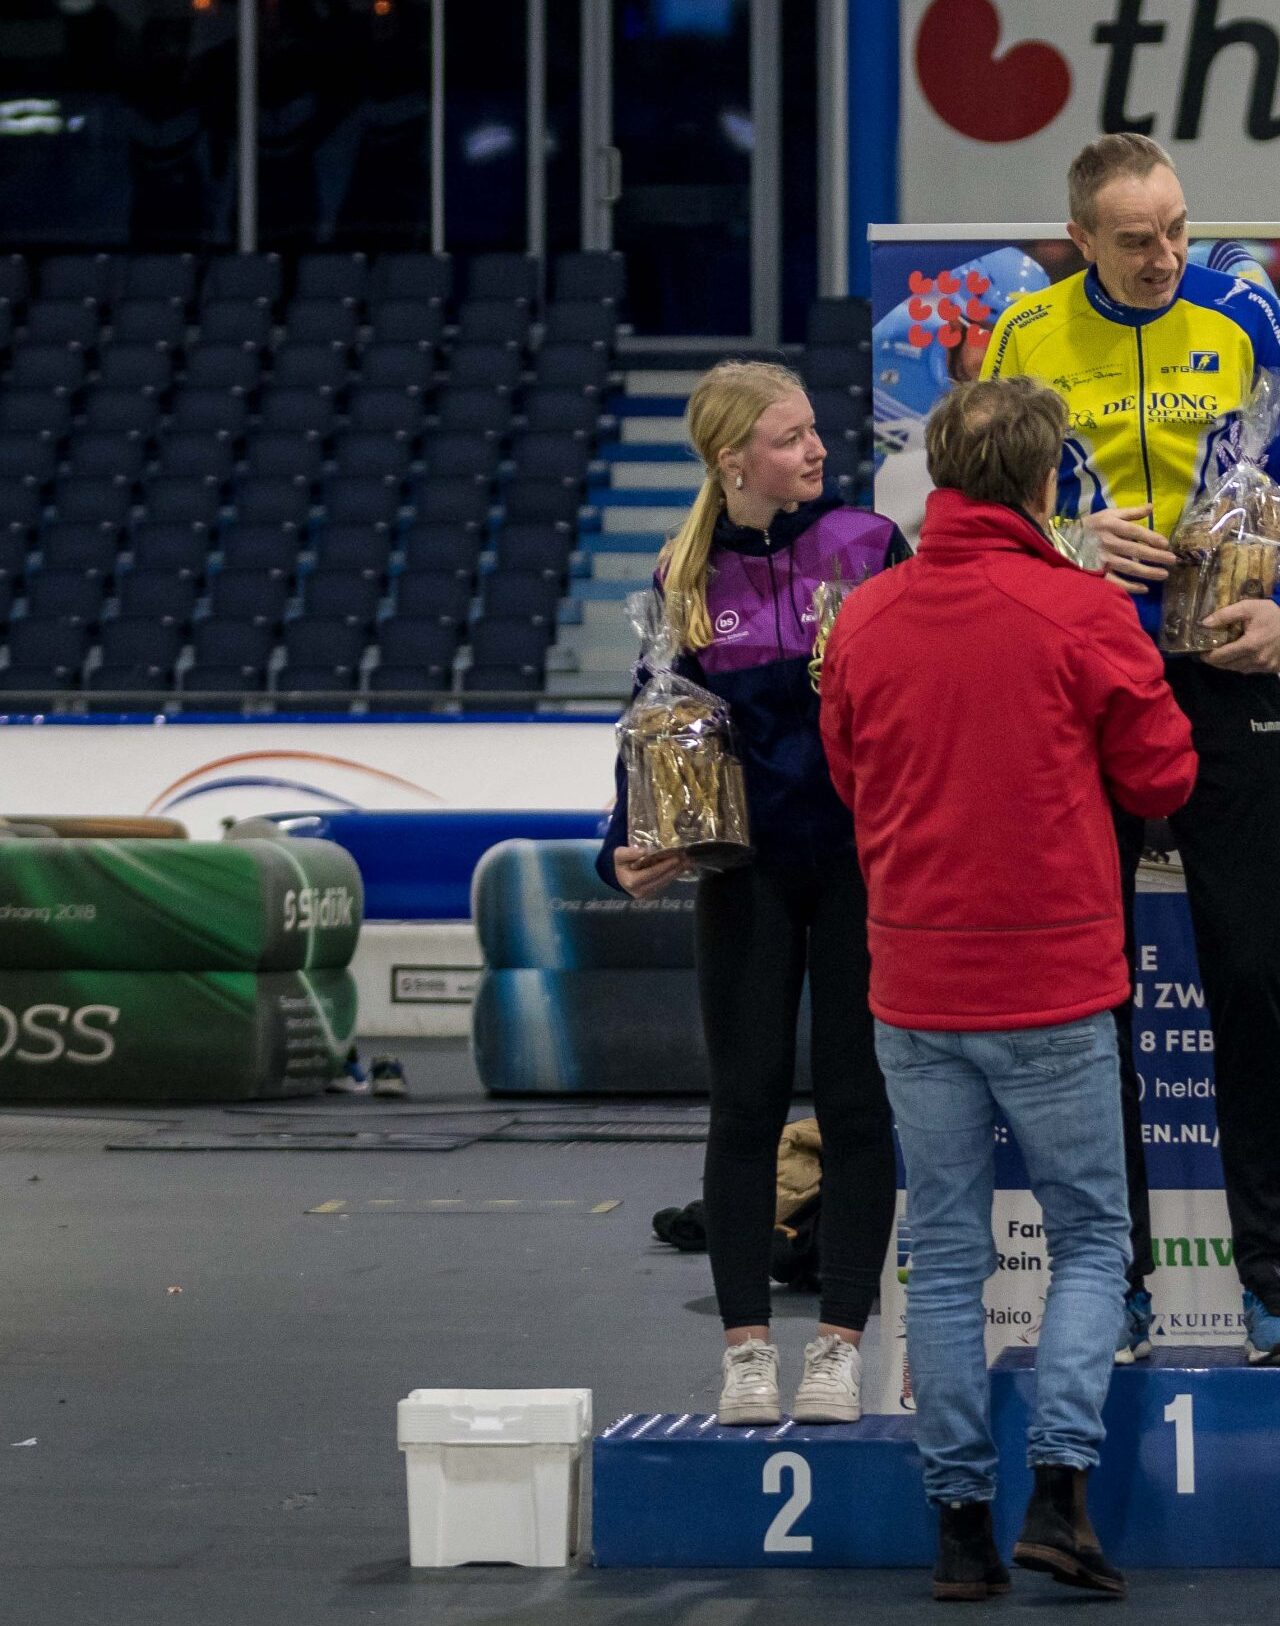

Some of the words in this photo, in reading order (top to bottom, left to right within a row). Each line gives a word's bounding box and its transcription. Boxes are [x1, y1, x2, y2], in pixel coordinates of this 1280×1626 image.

[1103, 395, 1136, 416] DE
[1147, 392, 1218, 412] JONG
[1148, 408, 1217, 420] OPTIEK
[1140, 1030, 1156, 1052] 8
[1156, 1077, 1216, 1098] held
[997, 1251, 1042, 1270] Rein
[985, 1306, 1032, 1325] Haico
[1164, 1393, 1196, 1494] 1
[762, 1451, 812, 1553] 2
